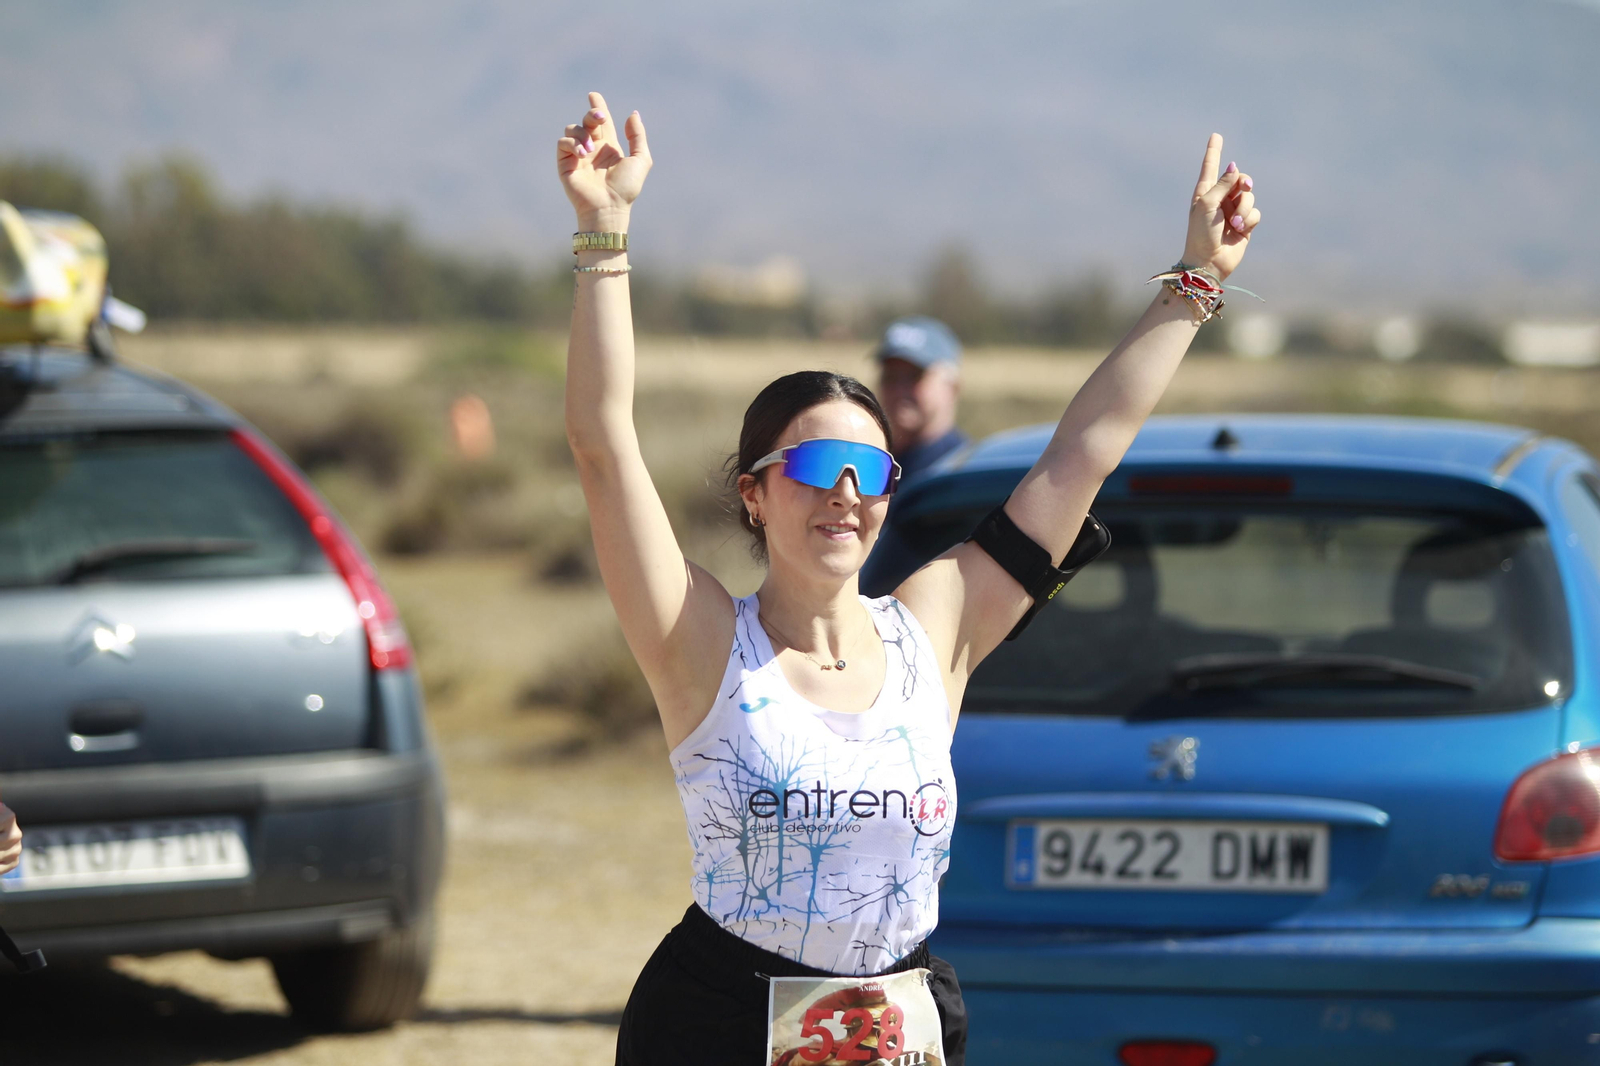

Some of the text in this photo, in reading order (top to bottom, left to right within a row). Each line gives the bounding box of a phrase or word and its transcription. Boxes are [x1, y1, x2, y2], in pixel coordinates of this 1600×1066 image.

[750, 821, 861, 835] club deportivo
[1042, 829, 1315, 881] 9422 DMW
[798, 1005, 905, 1061] 528
